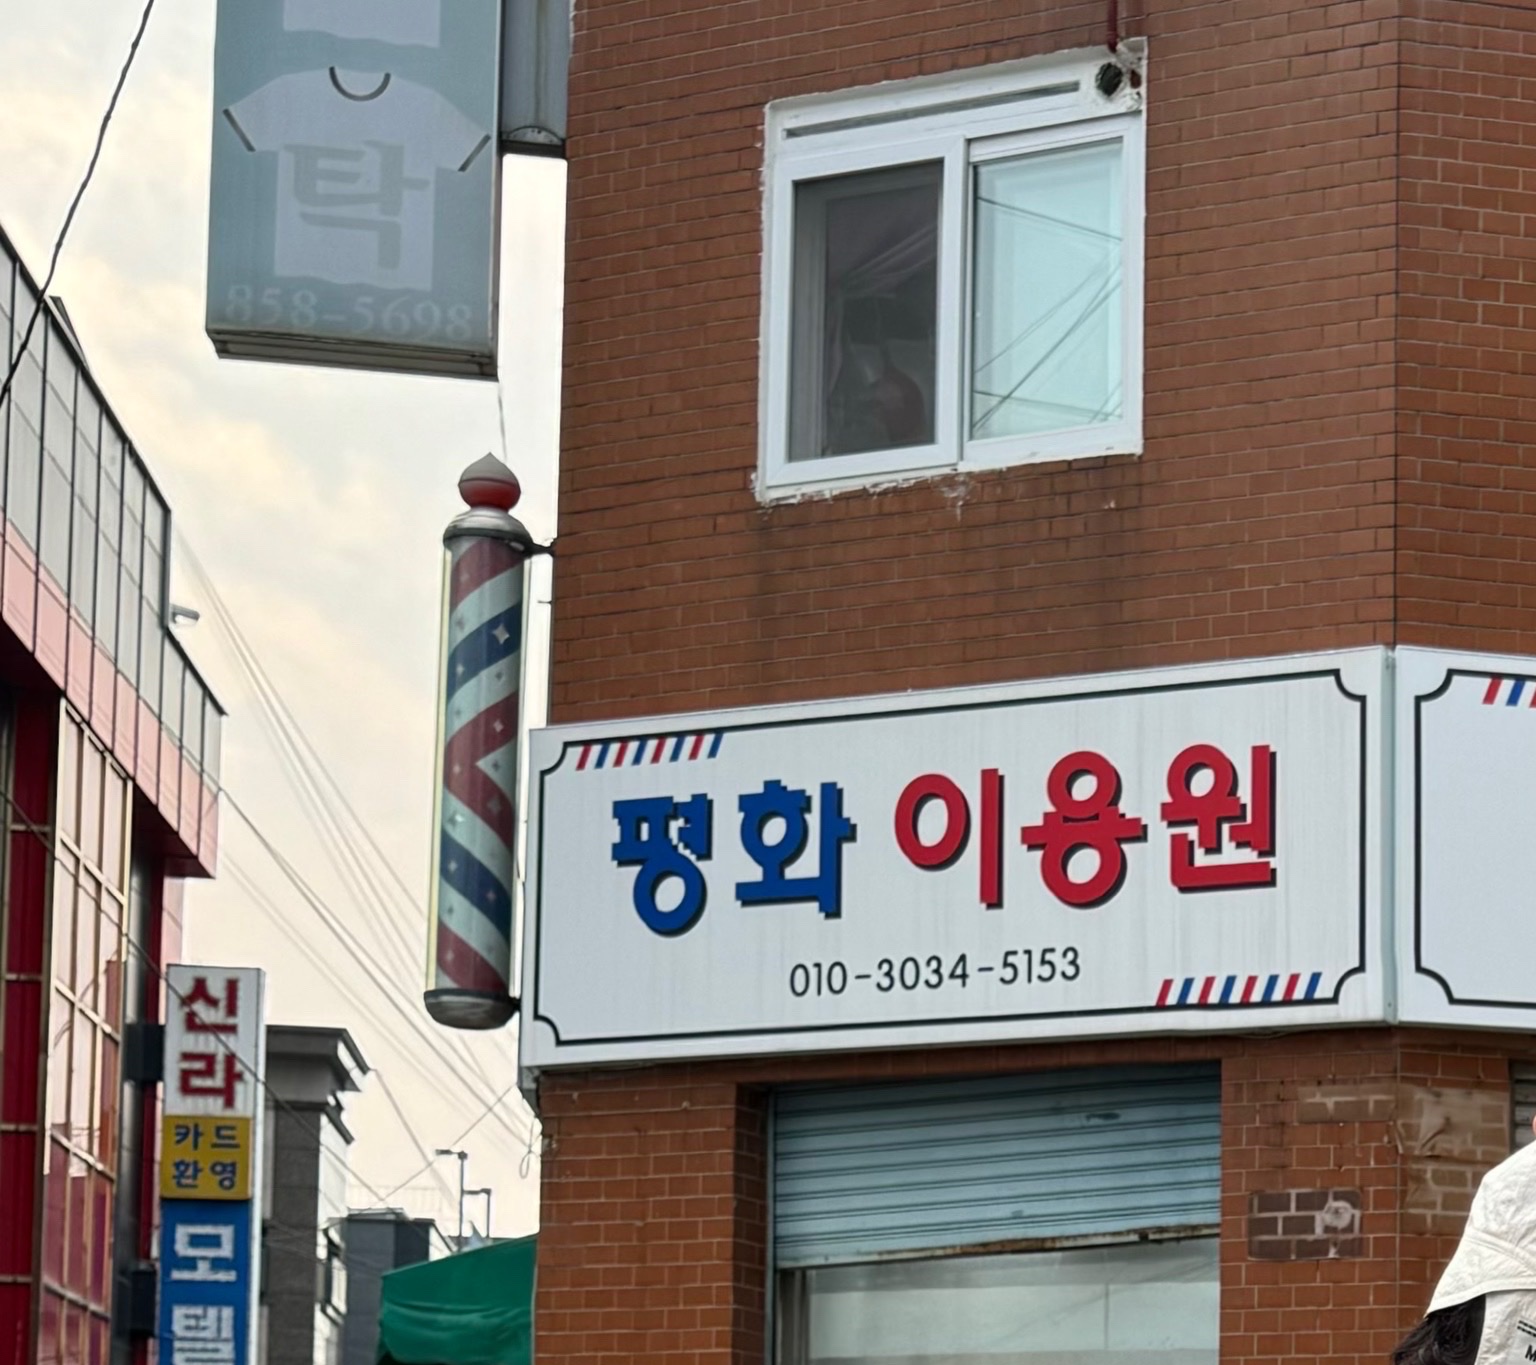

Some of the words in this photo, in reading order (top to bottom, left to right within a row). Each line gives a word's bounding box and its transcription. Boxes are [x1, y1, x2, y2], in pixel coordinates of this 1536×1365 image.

[284, 139, 431, 270] 탁
[226, 284, 473, 342] 858-5698
[612, 779, 856, 936] 평화
[894, 744, 1277, 909] 이용원
[789, 946, 1082, 998] 010-3034-5153
[178, 977, 245, 1110] 신라
[174, 1123, 241, 1150] 카드
[172, 1158, 238, 1191] 환영
